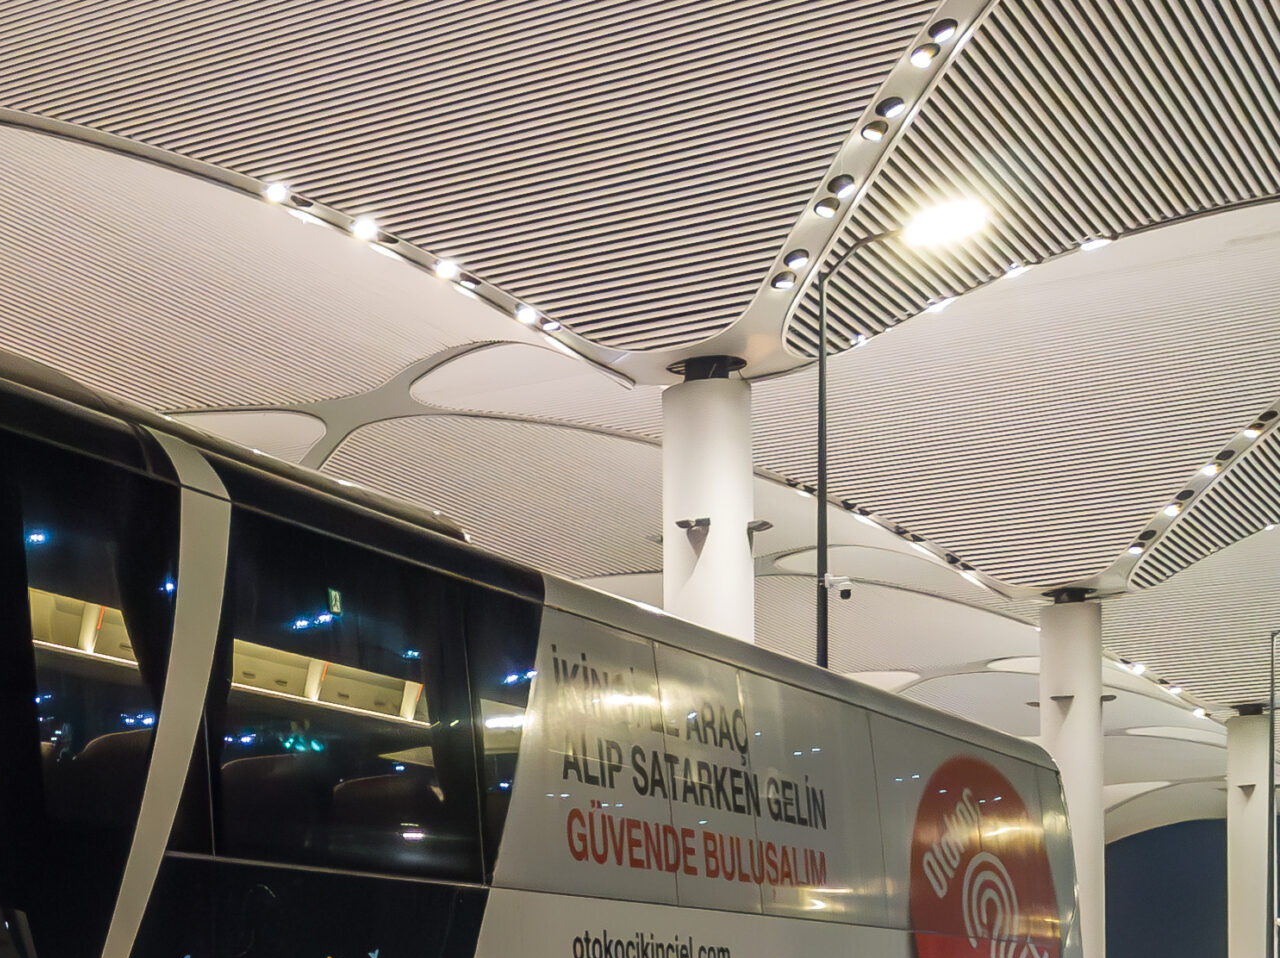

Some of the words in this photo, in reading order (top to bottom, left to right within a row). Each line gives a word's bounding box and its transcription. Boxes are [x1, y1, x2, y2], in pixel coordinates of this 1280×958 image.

[562, 735, 623, 789] ALIP
[631, 745, 761, 818] SATARKEN
[766, 775, 827, 831] GELİN
[567, 799, 698, 876] GÜVENDE
[703, 830, 827, 898] BULUŞALIM
